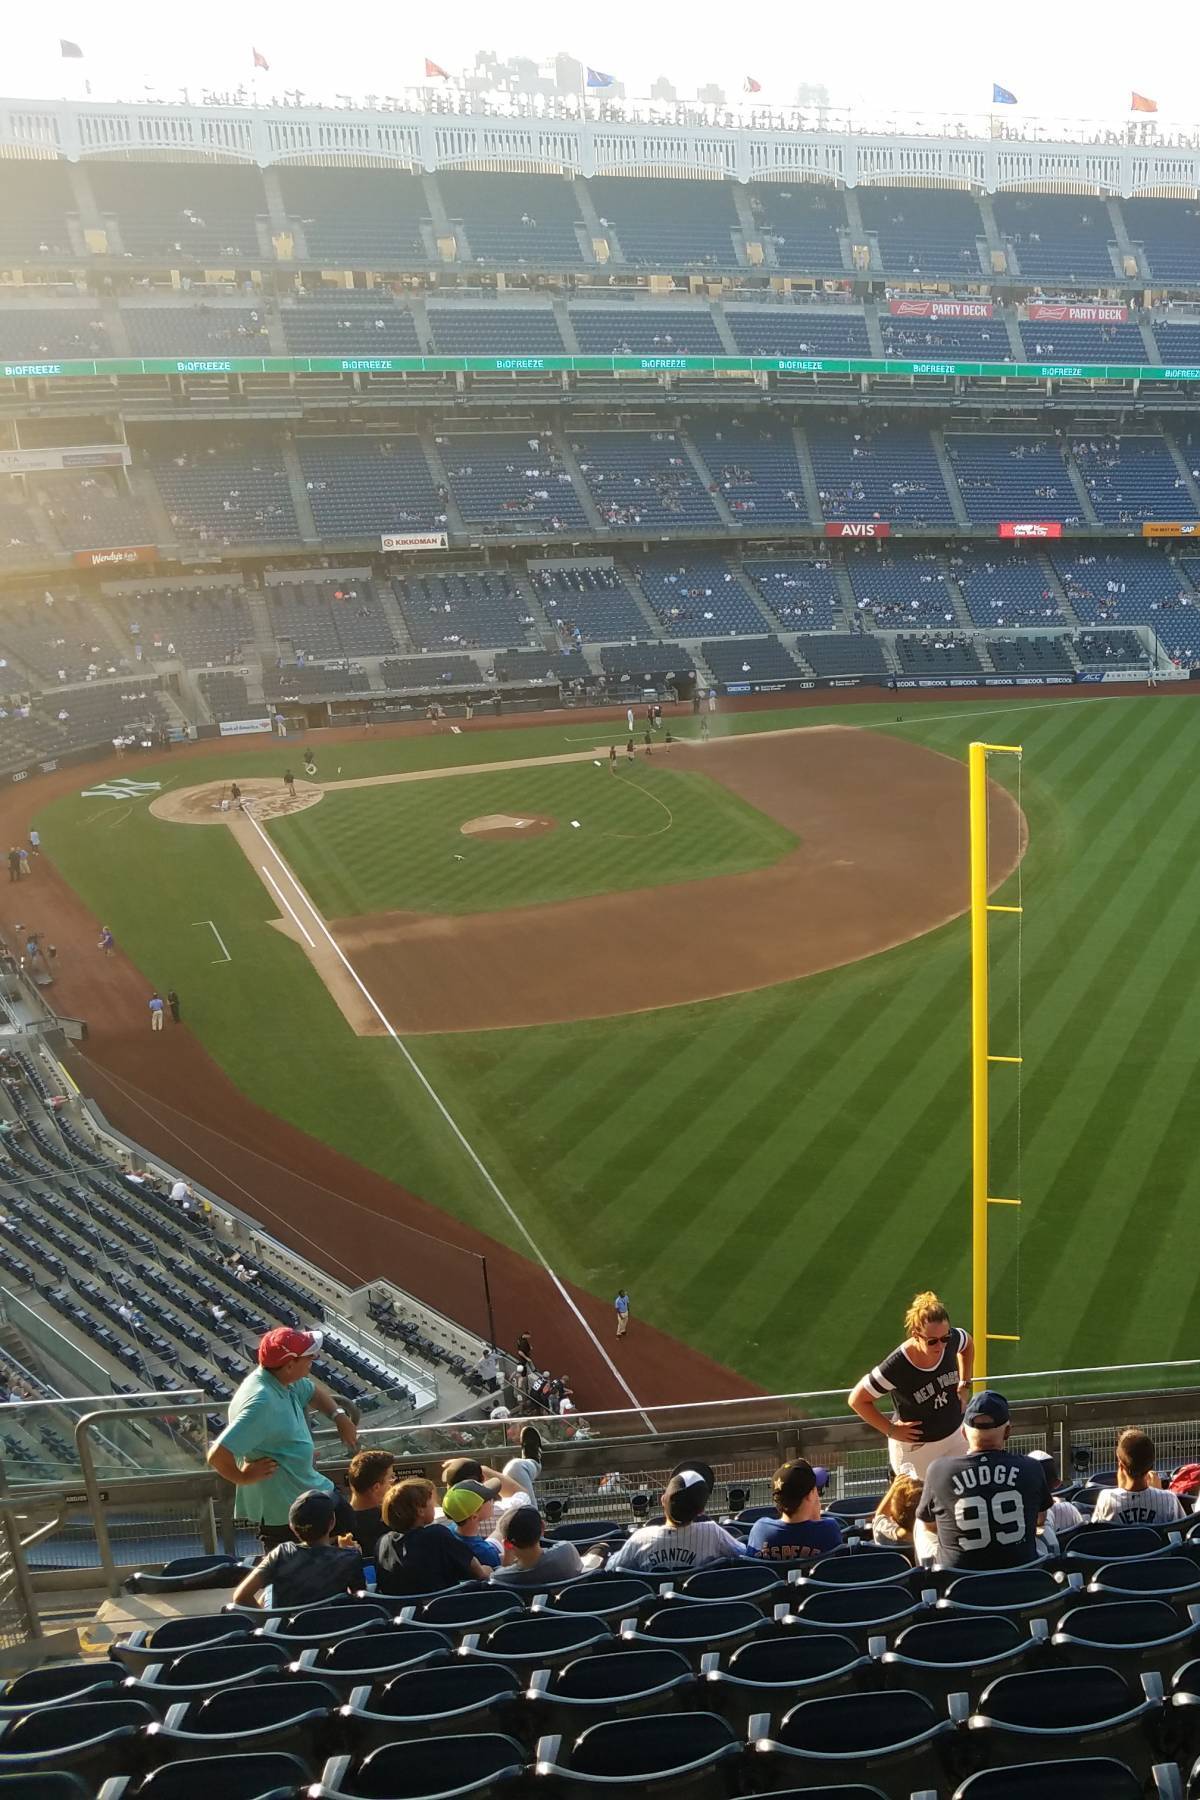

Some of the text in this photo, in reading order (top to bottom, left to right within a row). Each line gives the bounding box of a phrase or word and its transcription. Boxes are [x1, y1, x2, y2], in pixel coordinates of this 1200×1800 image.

[932, 303, 987, 317] PARTY DECK
[1069, 308, 1121, 320] PARTY DECK
[841, 524, 875, 536] AVIS
[395, 538, 437, 546] KIKKOMAN
[92, 551, 123, 565] Wendy's
[912, 1370, 961, 1405] NEW YORK
[952, 1464, 1020, 1495] JUDGE
[954, 1489, 1026, 1551] 99
[648, 1547, 697, 1567] STANTON
